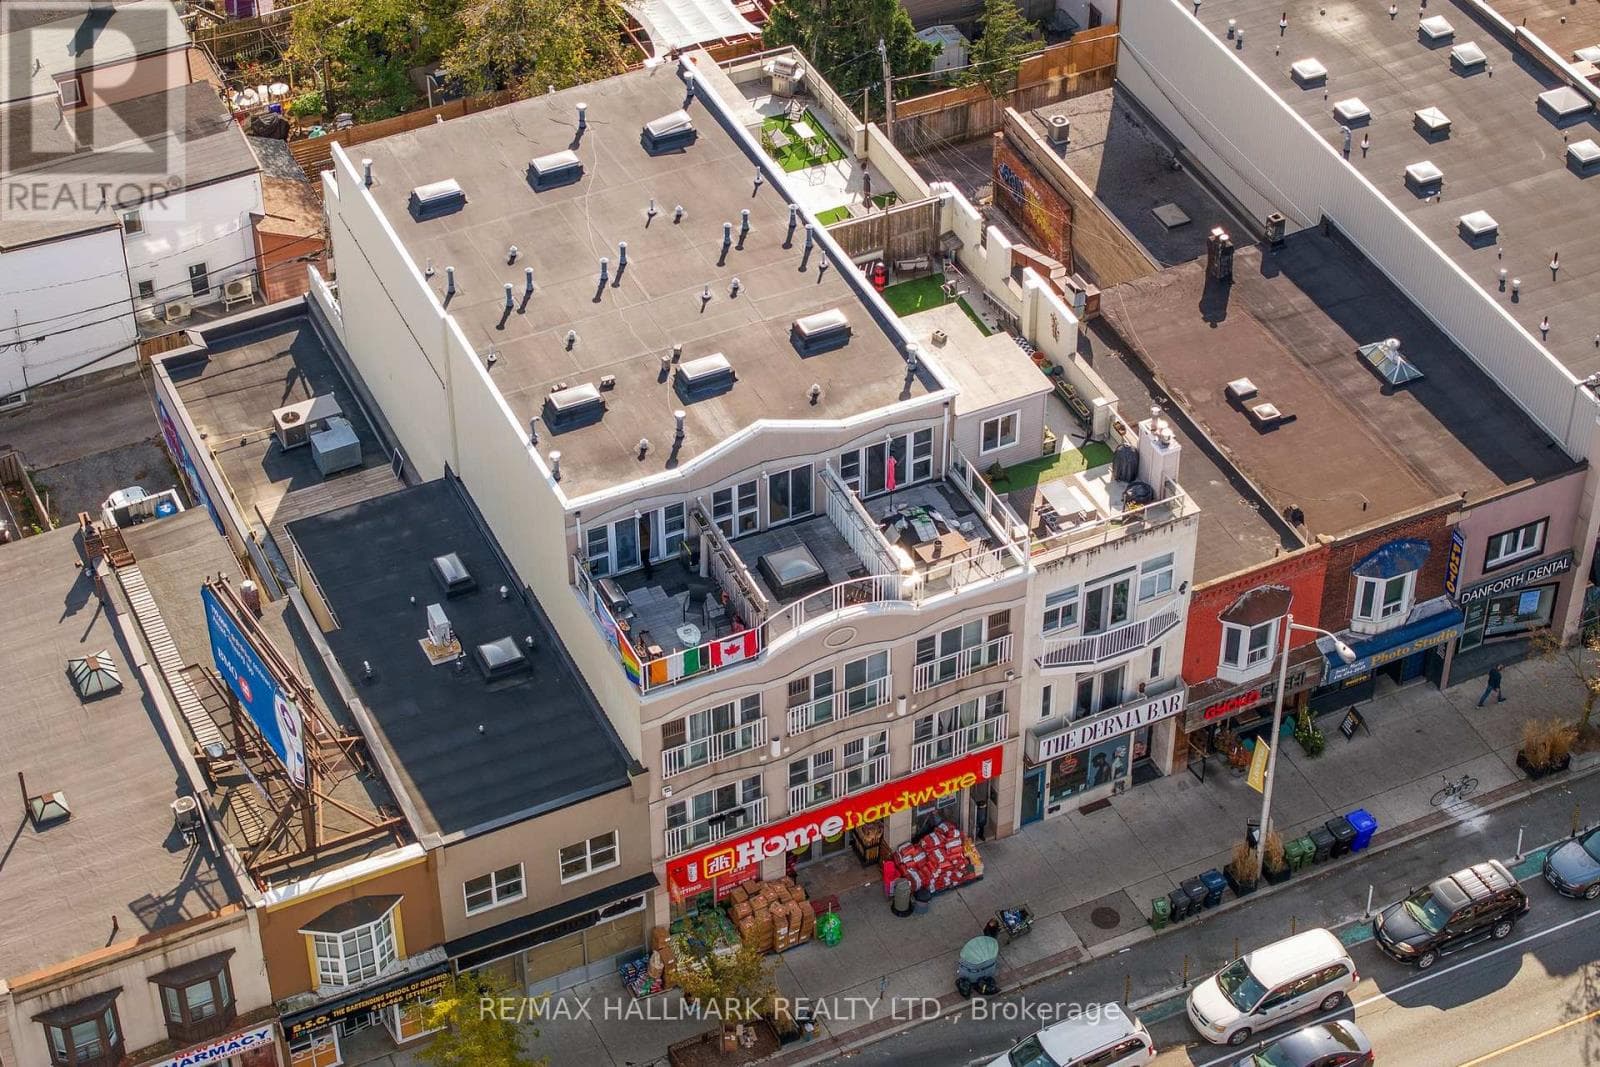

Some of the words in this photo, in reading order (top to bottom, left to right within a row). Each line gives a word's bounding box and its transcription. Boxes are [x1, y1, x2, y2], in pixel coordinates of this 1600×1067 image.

[1461, 574, 1524, 604] DANFORTH
[1527, 558, 1569, 582] DENTAL
[1370, 646, 1410, 666] Photo
[1413, 629, 1458, 651] Studio
[1043, 731, 1076, 756] THE
[1081, 709, 1141, 744] DERMA
[1147, 694, 1181, 721] BAR
[736, 814, 845, 868] Home
[843, 771, 978, 830] hardware
[292, 1015, 330, 1034] B.S.O.
[332, 1008, 346, 1018] THE
[385, 986, 410, 1000] SCHOOL
